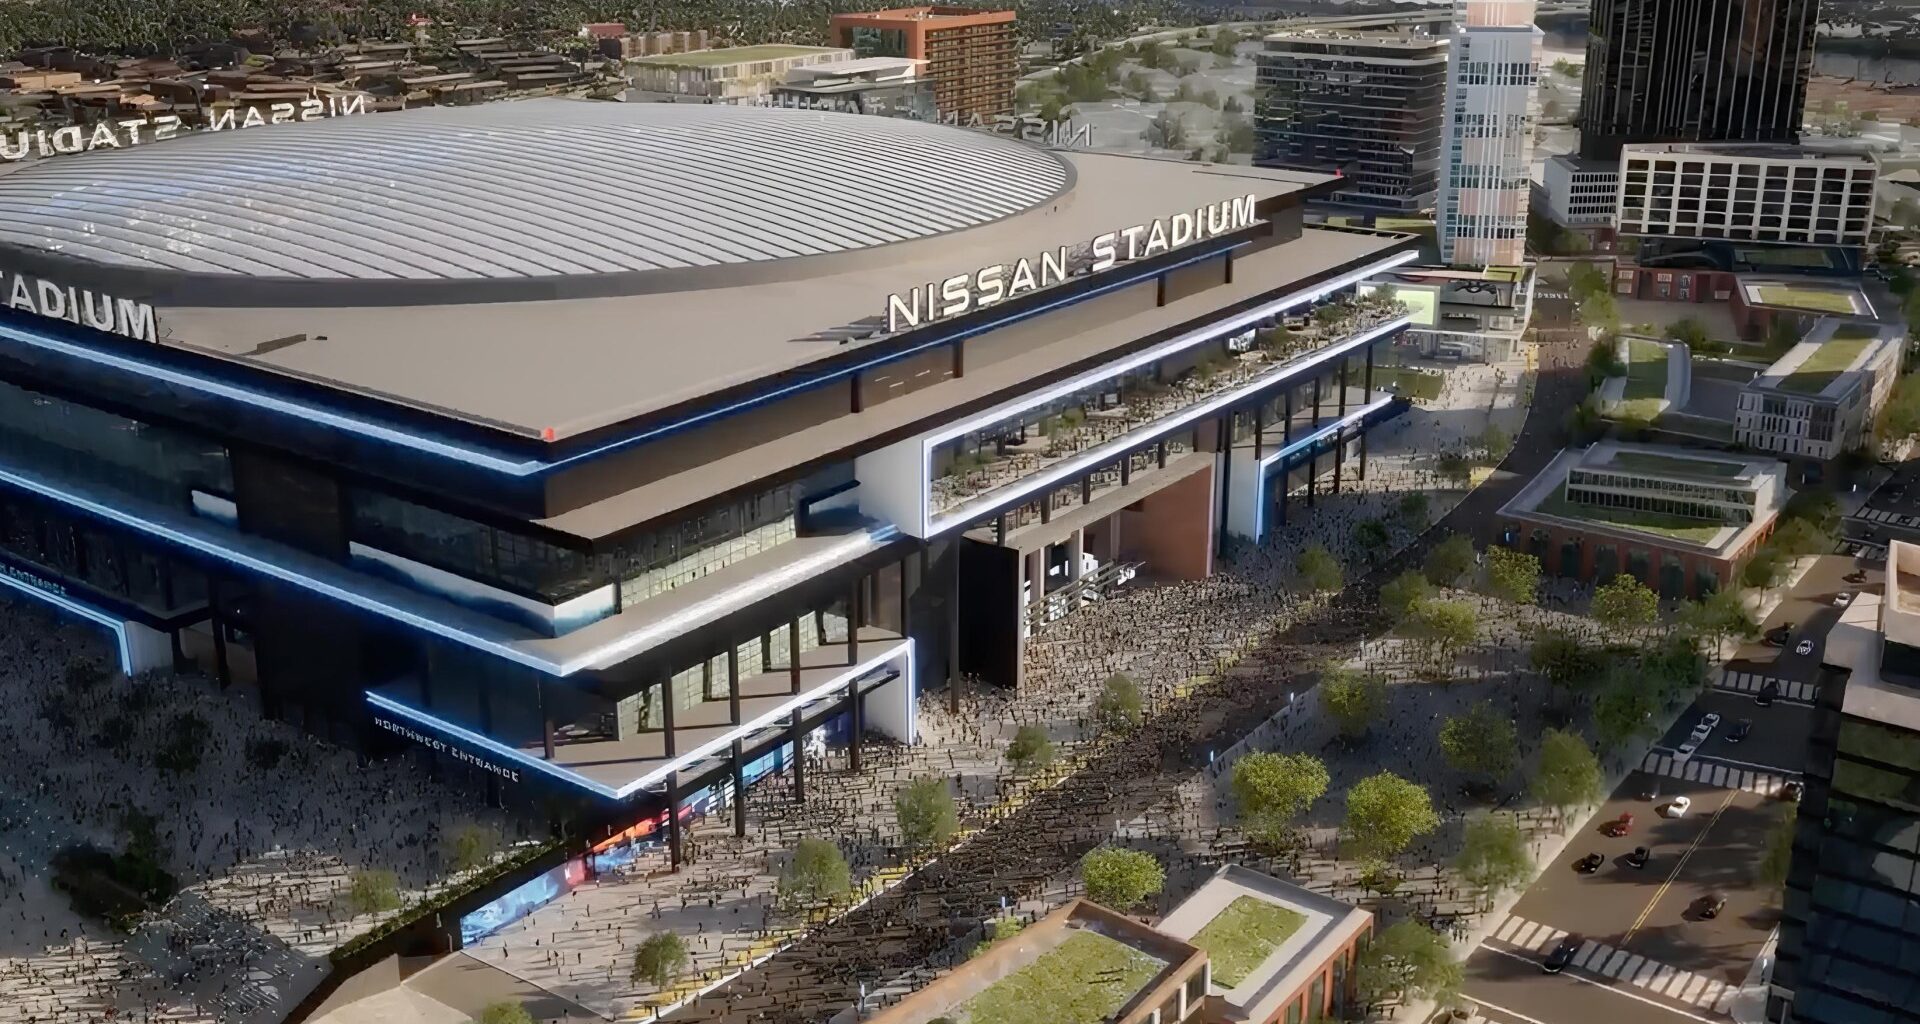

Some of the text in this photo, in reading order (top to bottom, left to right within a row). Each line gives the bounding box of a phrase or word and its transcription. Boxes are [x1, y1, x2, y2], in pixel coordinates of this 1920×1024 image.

[0, 271, 159, 344] ADIUM
[888, 193, 1255, 333] NISSAN STADIUM
